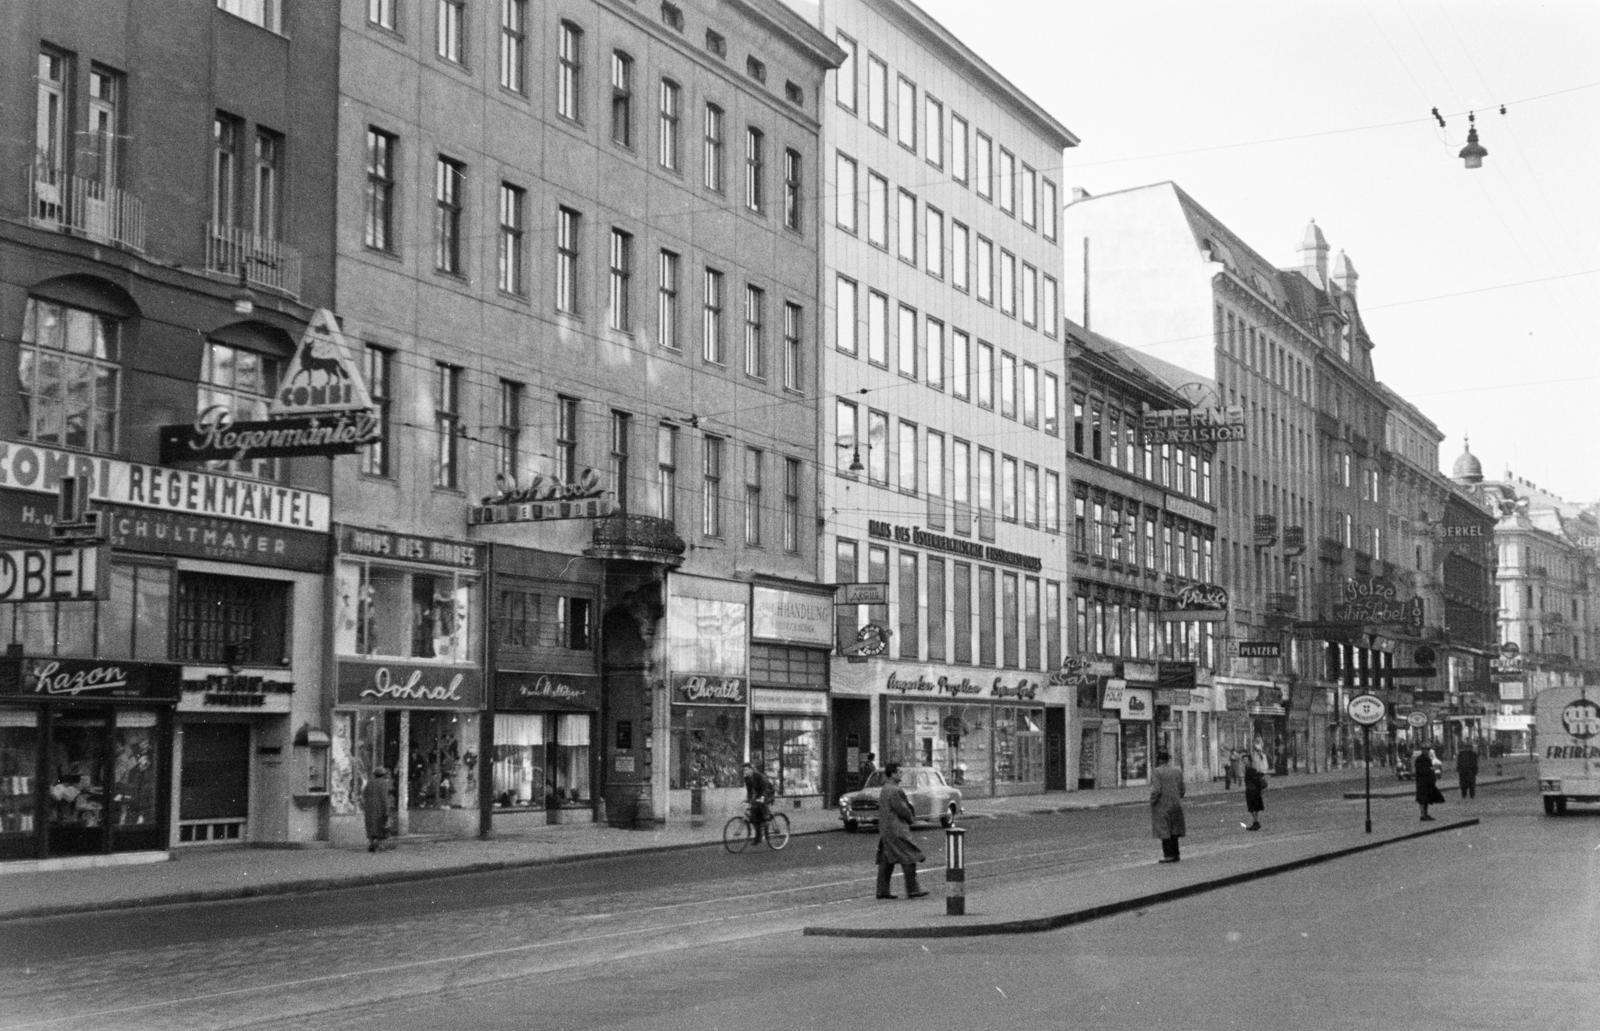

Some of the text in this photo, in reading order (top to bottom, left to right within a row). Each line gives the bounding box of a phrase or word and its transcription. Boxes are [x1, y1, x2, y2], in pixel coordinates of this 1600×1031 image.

[280, 384, 352, 407] COMBI
[127, 462, 316, 529] REGENMÄNTEL
[117, 517, 286, 555] CHULTMAYER
[1440, 525, 1484, 538] BERKEL
